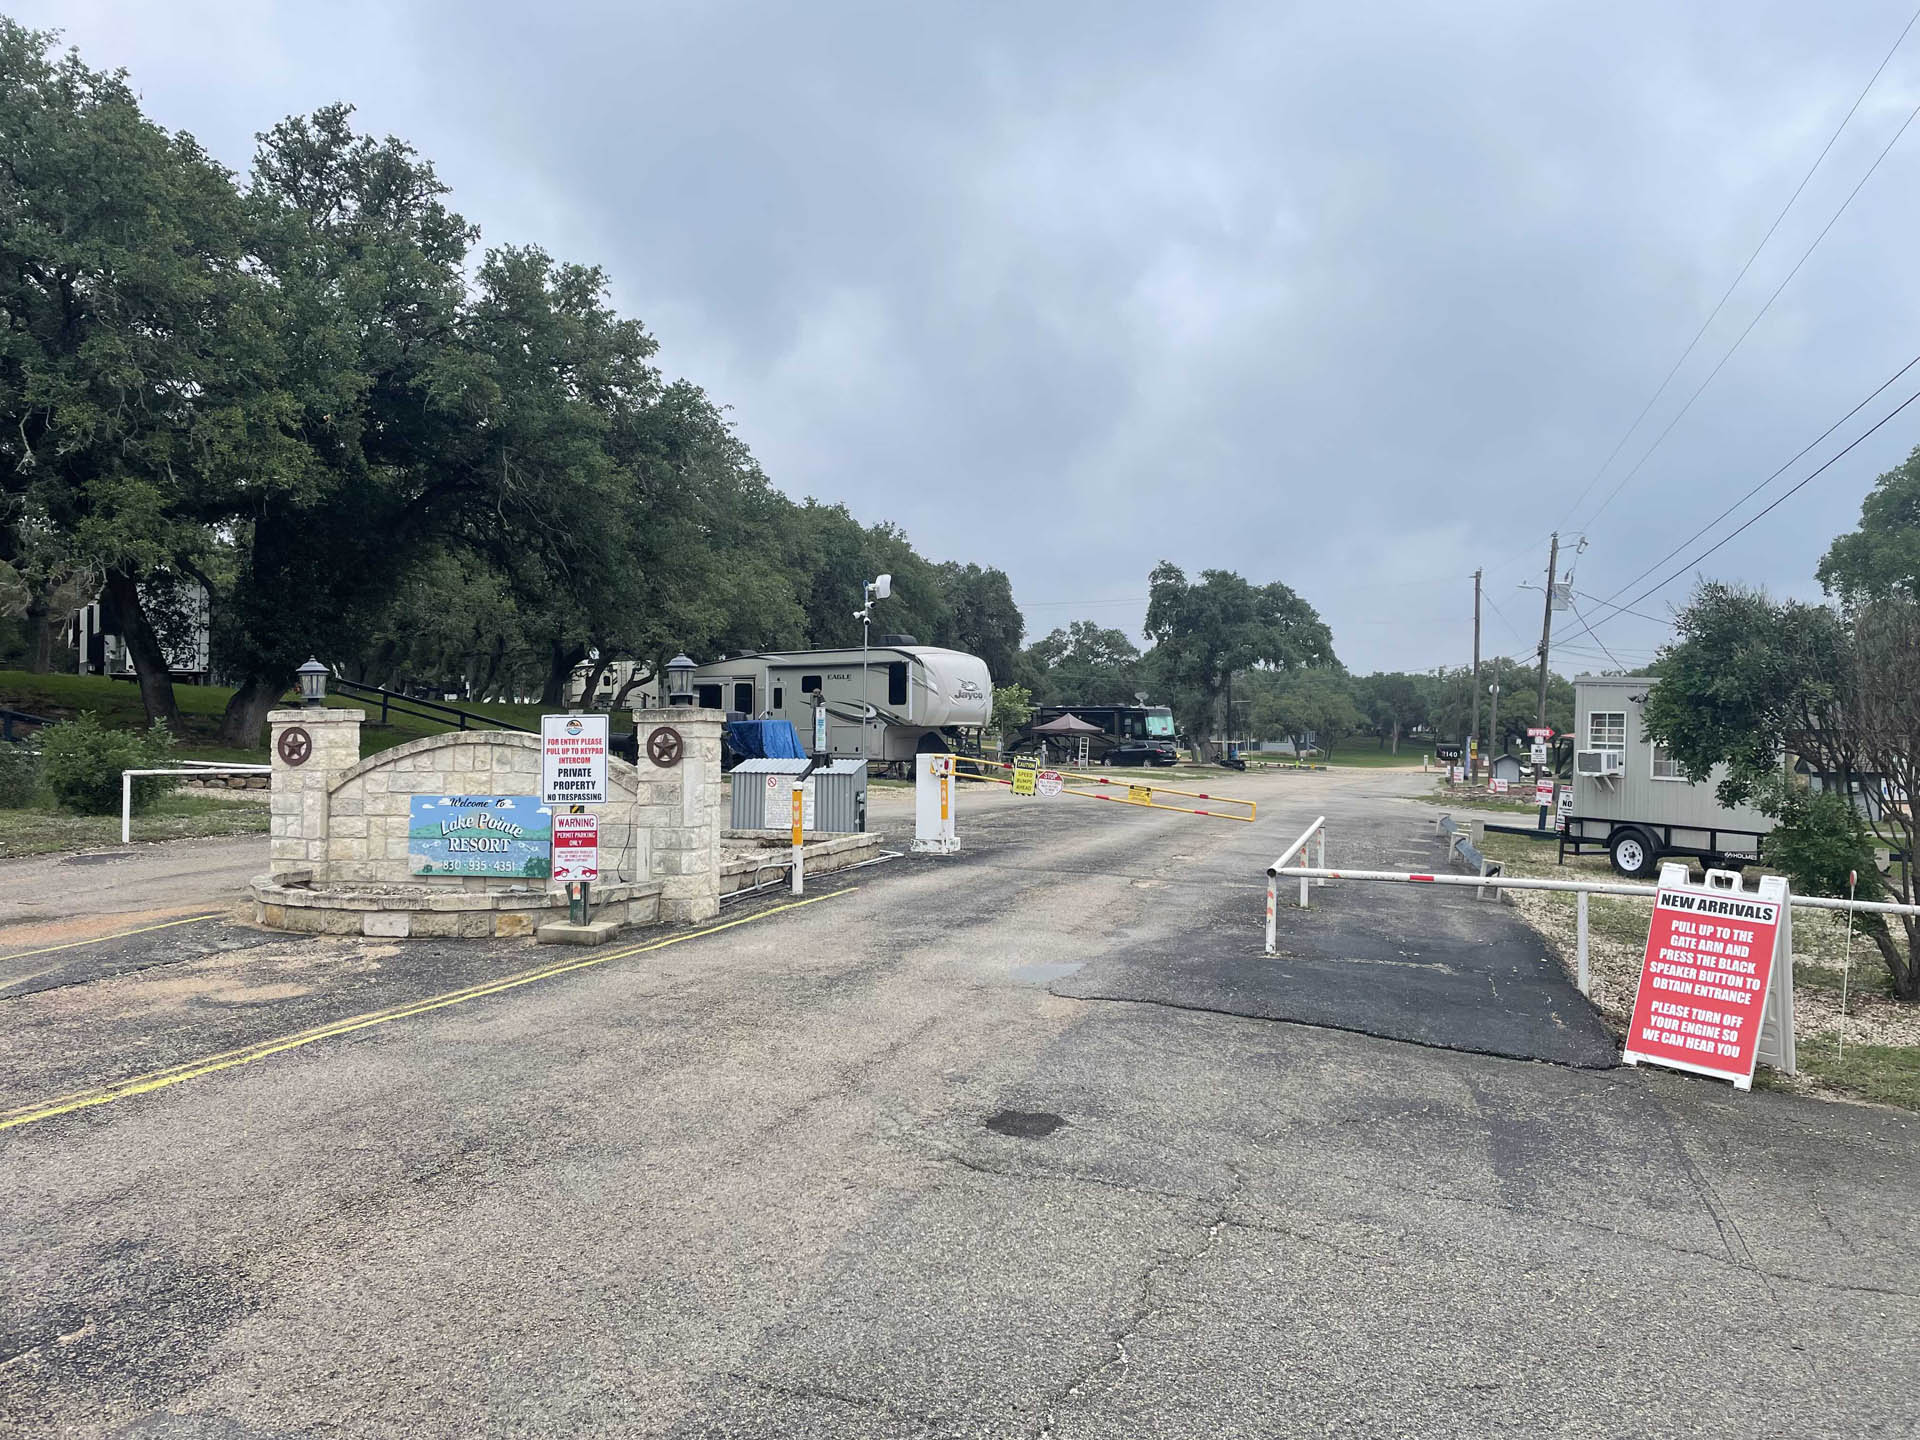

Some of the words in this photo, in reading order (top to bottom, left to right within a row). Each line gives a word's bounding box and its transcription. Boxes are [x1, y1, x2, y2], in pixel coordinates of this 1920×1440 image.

[954, 690, 983, 700] Jayco
[558, 768, 592, 777] PRIVATE
[1044, 772, 1058, 780] STOP
[554, 781, 596, 790] PROPERTY
[450, 798, 488, 808] Welcome
[496, 799, 505, 808] to
[440, 815, 474, 836] Lake
[478, 812, 524, 838] Pointe
[558, 818, 594, 828] WARNING
[448, 838, 512, 852] RESORT
[442, 861, 460, 871] 830
[468, 861, 487, 871] 935
[494, 861, 515, 872] 4351
[1661, 894, 1695, 909] NEW
[1697, 899, 1773, 920] ARRIVALS
[1671, 920, 1697, 934] PULL
[1698, 924, 1714, 936] UP
[1716, 926, 1730, 940] TO
[1733, 929, 1754, 943] THE
[1670, 934, 1697, 950] GATE
[1698, 940, 1724, 954] ARM
[1724, 944, 1750, 958] AND
[1659, 948, 1694, 964] PRESS
[1696, 954, 1717, 968] THE
[1718, 958, 1756, 974] BLACK
[1649, 961, 1697, 980] SPEAKER
[1698, 970, 1744, 988] BUTTON
[1746, 978, 1761, 990] TO
[1653, 976, 1693, 994] OBTAIN
[1694, 984, 1752, 1005] ENTRANCE
[1651, 1000, 1690, 1018] PLEASE
[1692, 1008, 1722, 1024] TURN
[1722, 1014, 1744, 1028] OFF
[1650, 1014, 1680, 1031] YOUR
[1680, 1021, 1720, 1039] ENGINE
[1722, 1029, 1738, 1042] SO
[1642, 1028, 1660, 1042] WE
[1661, 1032, 1684, 1047] CAN
[1686, 1037, 1715, 1053] HEAR
[1717, 1043, 1740, 1058] YOU
